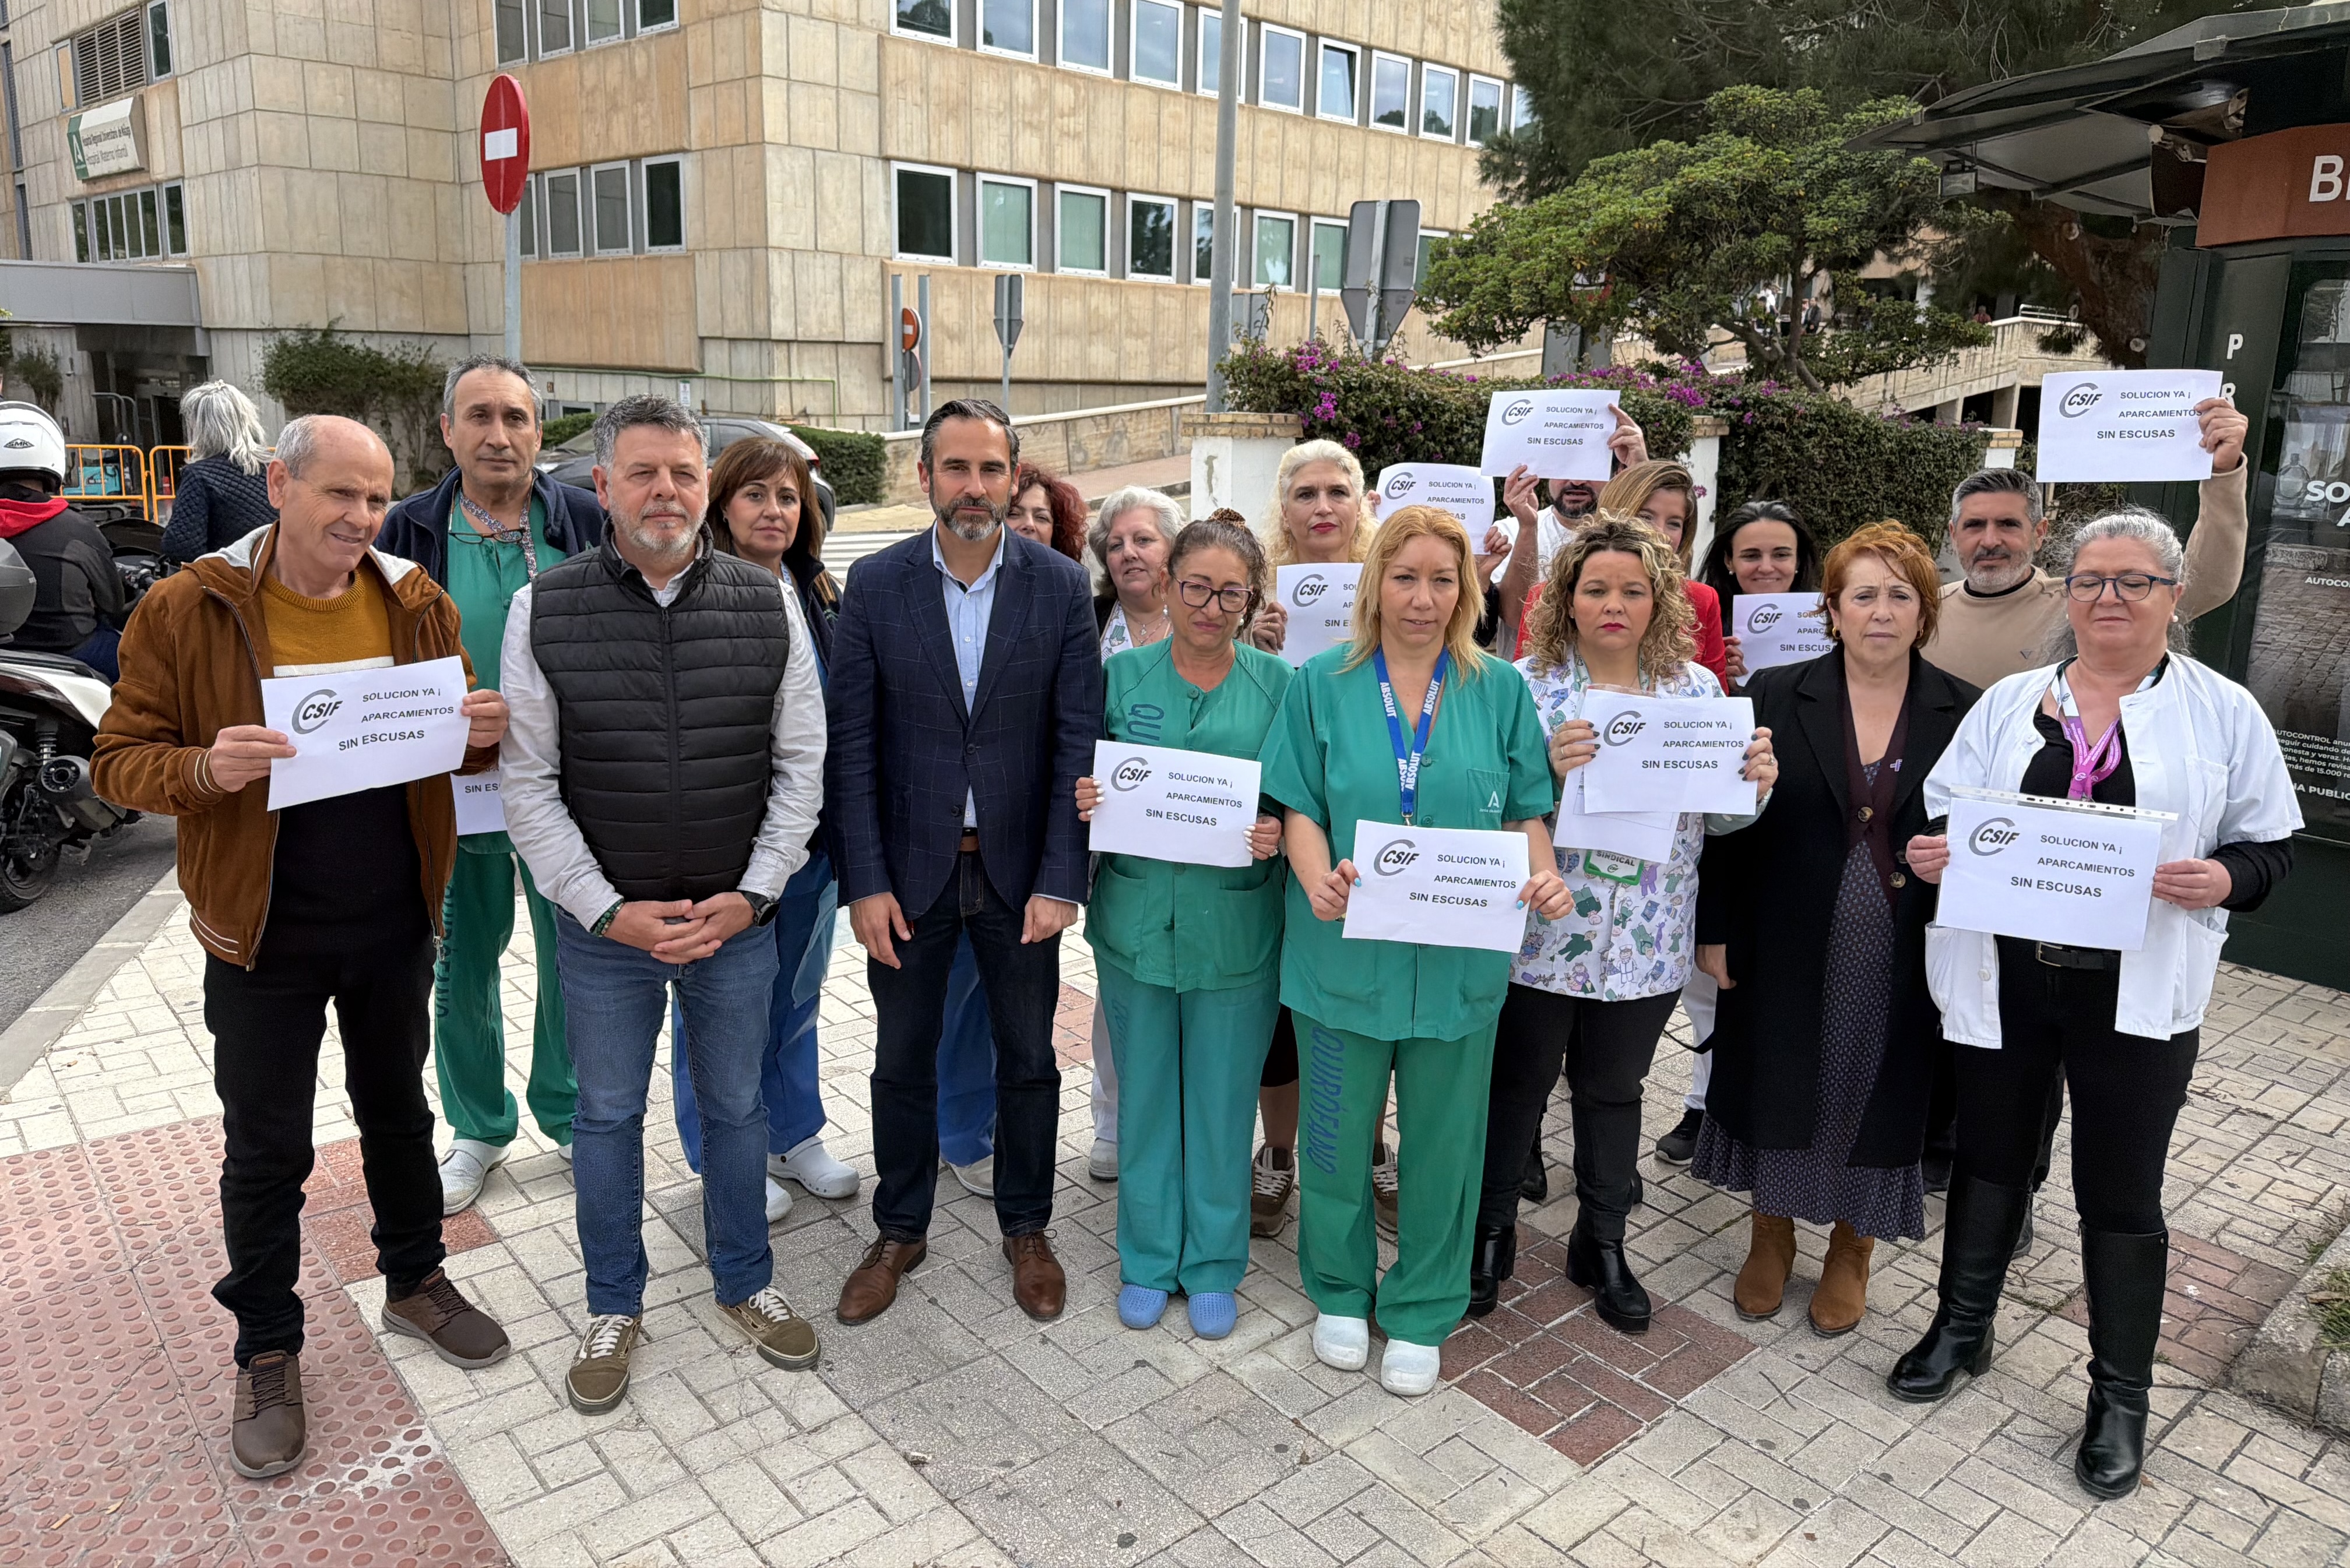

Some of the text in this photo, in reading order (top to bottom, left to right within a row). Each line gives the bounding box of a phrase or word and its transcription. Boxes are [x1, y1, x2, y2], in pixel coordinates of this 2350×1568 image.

[2309, 155, 2350, 202] B
[2120, 391, 2170, 399] SOLUCION
[2119, 409, 2202, 418] APARCAMIENTOS
[2097, 429, 2175, 439] SIN ESCUSAS
[2305, 577, 2350, 588] AUTOCO
[362, 690, 417, 702] SOLUCION
[1380, 682, 1397, 718] ABSOLUT
[1422, 678, 1440, 716] ABSOLUT
[361, 706, 454, 723] APARCAMIENTOS
[339, 730, 425, 751] SIN ESCUSAS
[2302, 742, 2339, 753] cuidando
[1641, 760, 1718, 769] SIN ESCUSAS
[2299, 757, 2326, 767] hemos
[1405, 751, 1421, 790] ABSOLUT
[2317, 767, 2342, 777] 15.000
[1168, 772, 1214, 784] SOLUCION
[1216, 778, 1228, 786] YA
[465, 785, 481, 793] SIN
[1166, 792, 1243, 808] APARCAMIENTOS
[1146, 809, 1216, 826] SIN ESCUSAS
[2040, 834, 2098, 850] SOLUCION
[2102, 843, 2116, 852] YA
[1437, 854, 1487, 866] SOLUCION
[1489, 858, 1500, 866] YA
[1596, 851, 1635, 866] SINDICAL
[2037, 857, 2135, 877] APARCAMIENTOS
[1434, 875, 1516, 889] APARCAMIENTOS
[2011, 876, 2102, 897] SIN ESCUSAS
[1409, 893, 1488, 907] SIN ESCUSAS
